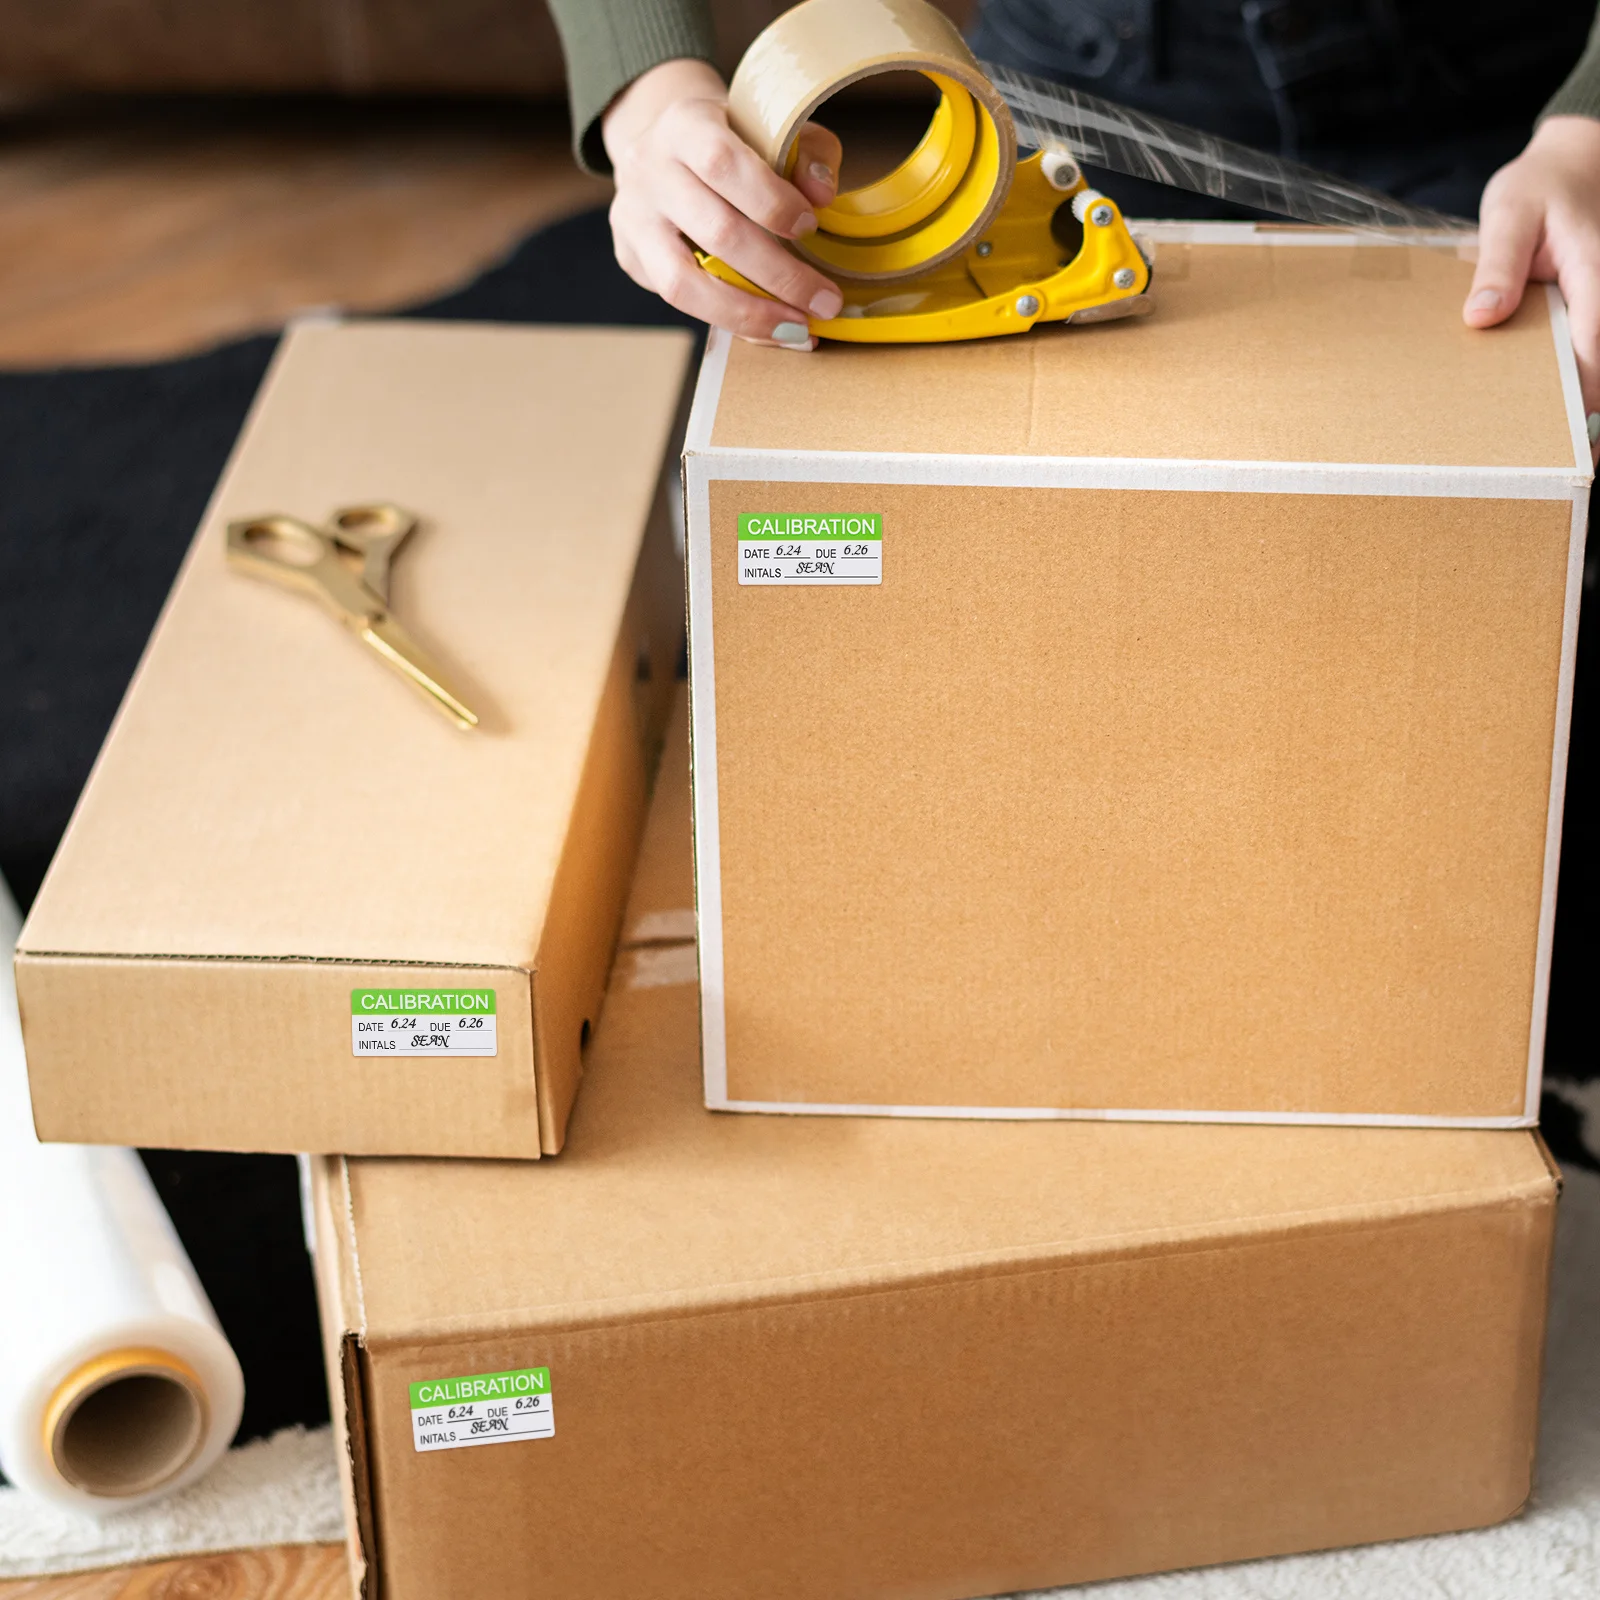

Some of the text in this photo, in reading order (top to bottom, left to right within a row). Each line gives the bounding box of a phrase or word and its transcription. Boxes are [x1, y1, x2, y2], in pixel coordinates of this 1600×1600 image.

[748, 519, 875, 535] CALIBRATION
[744, 545, 868, 558] DATE 6.24 DUE 6.26
[745, 562, 835, 578] INITALS SEAN
[361, 994, 488, 1009] CALIBRATION
[358, 1018, 483, 1031] DATE 6.24 DUE 6.26
[359, 1035, 450, 1049] INITALS SEAN
[419, 1373, 544, 1403] CALIBRATION
[418, 1396, 540, 1426] DATE 6.24 DUE 6.26
[420, 1418, 509, 1445] INITALS SEAN
